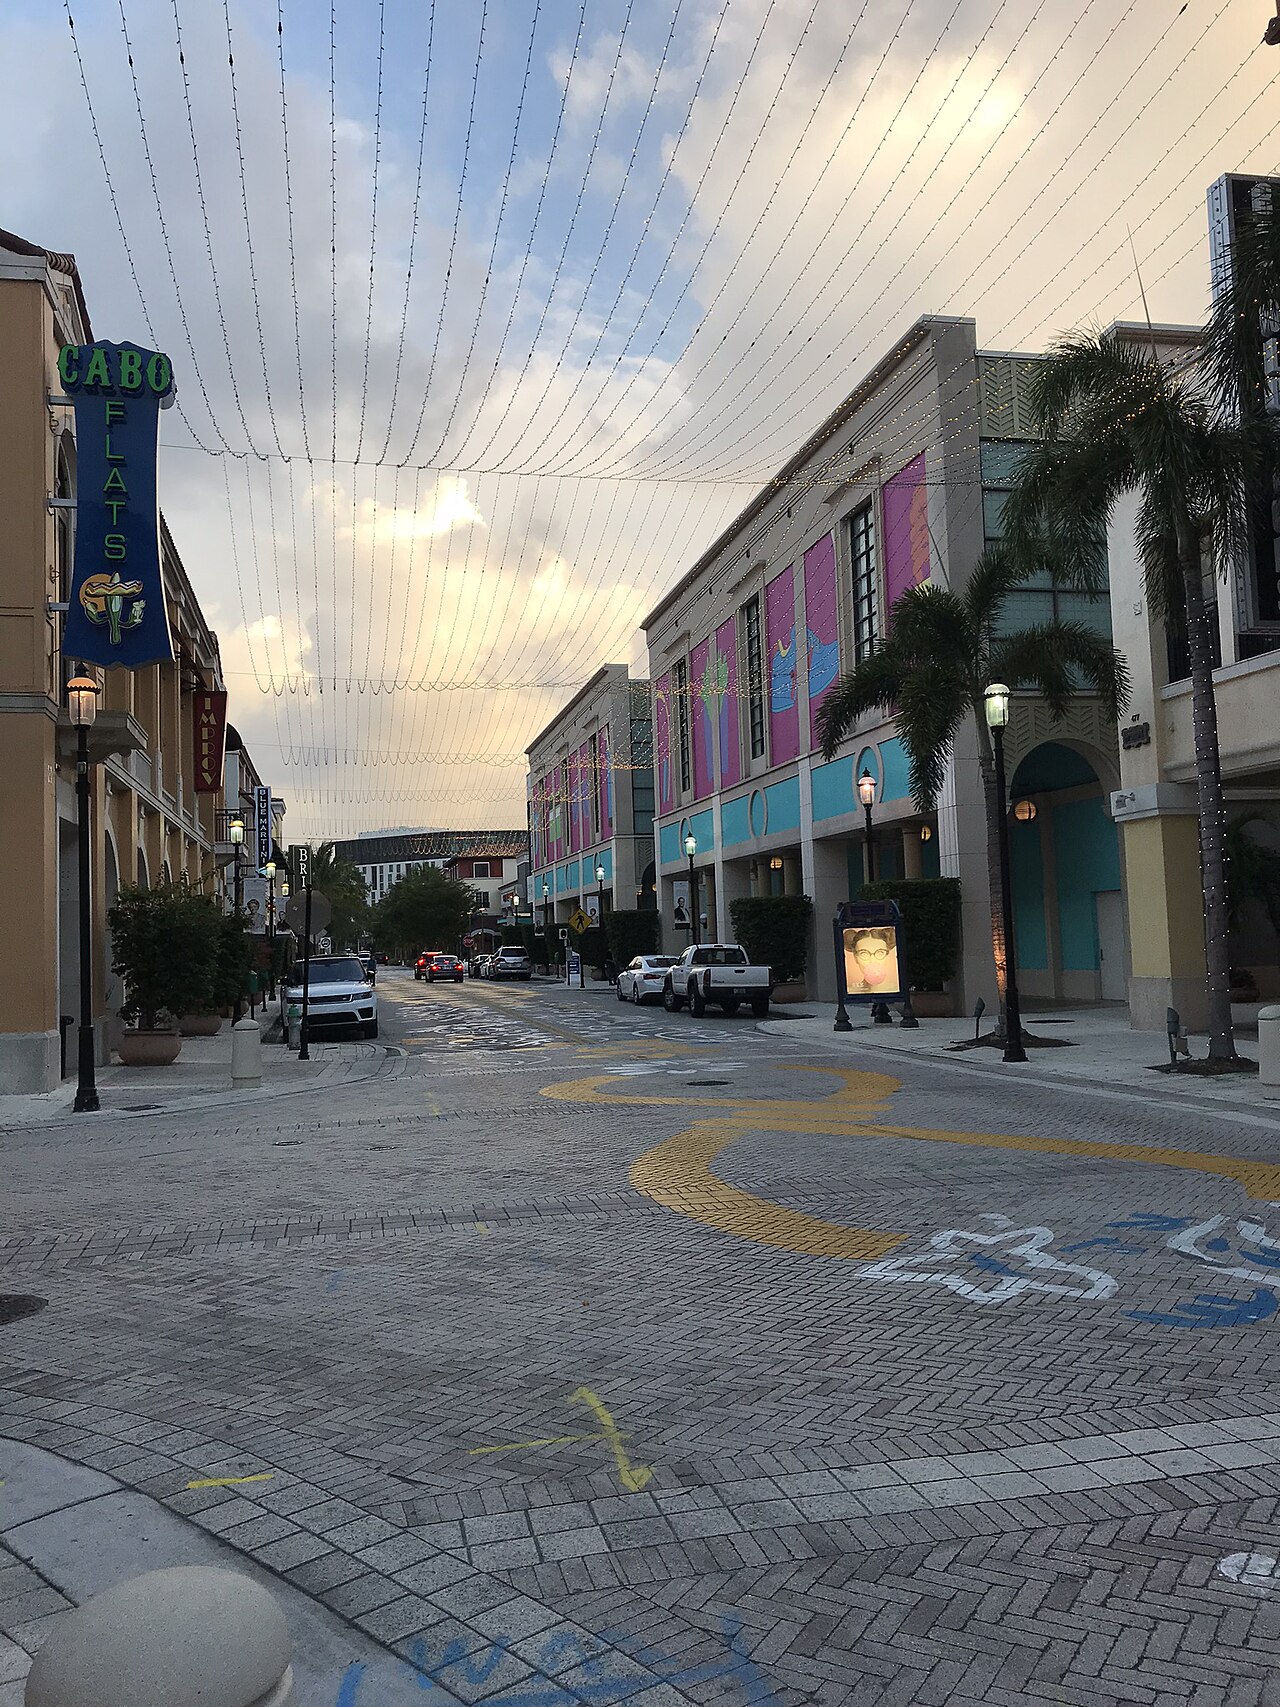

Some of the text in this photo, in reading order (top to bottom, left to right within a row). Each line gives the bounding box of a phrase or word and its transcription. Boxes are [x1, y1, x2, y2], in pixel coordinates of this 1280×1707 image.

[56, 344, 171, 392] CABO
[103, 400, 128, 560] FLATS
[199, 697, 217, 786] IMPROV
[259, 788, 268, 864] BLUE MARTINI
